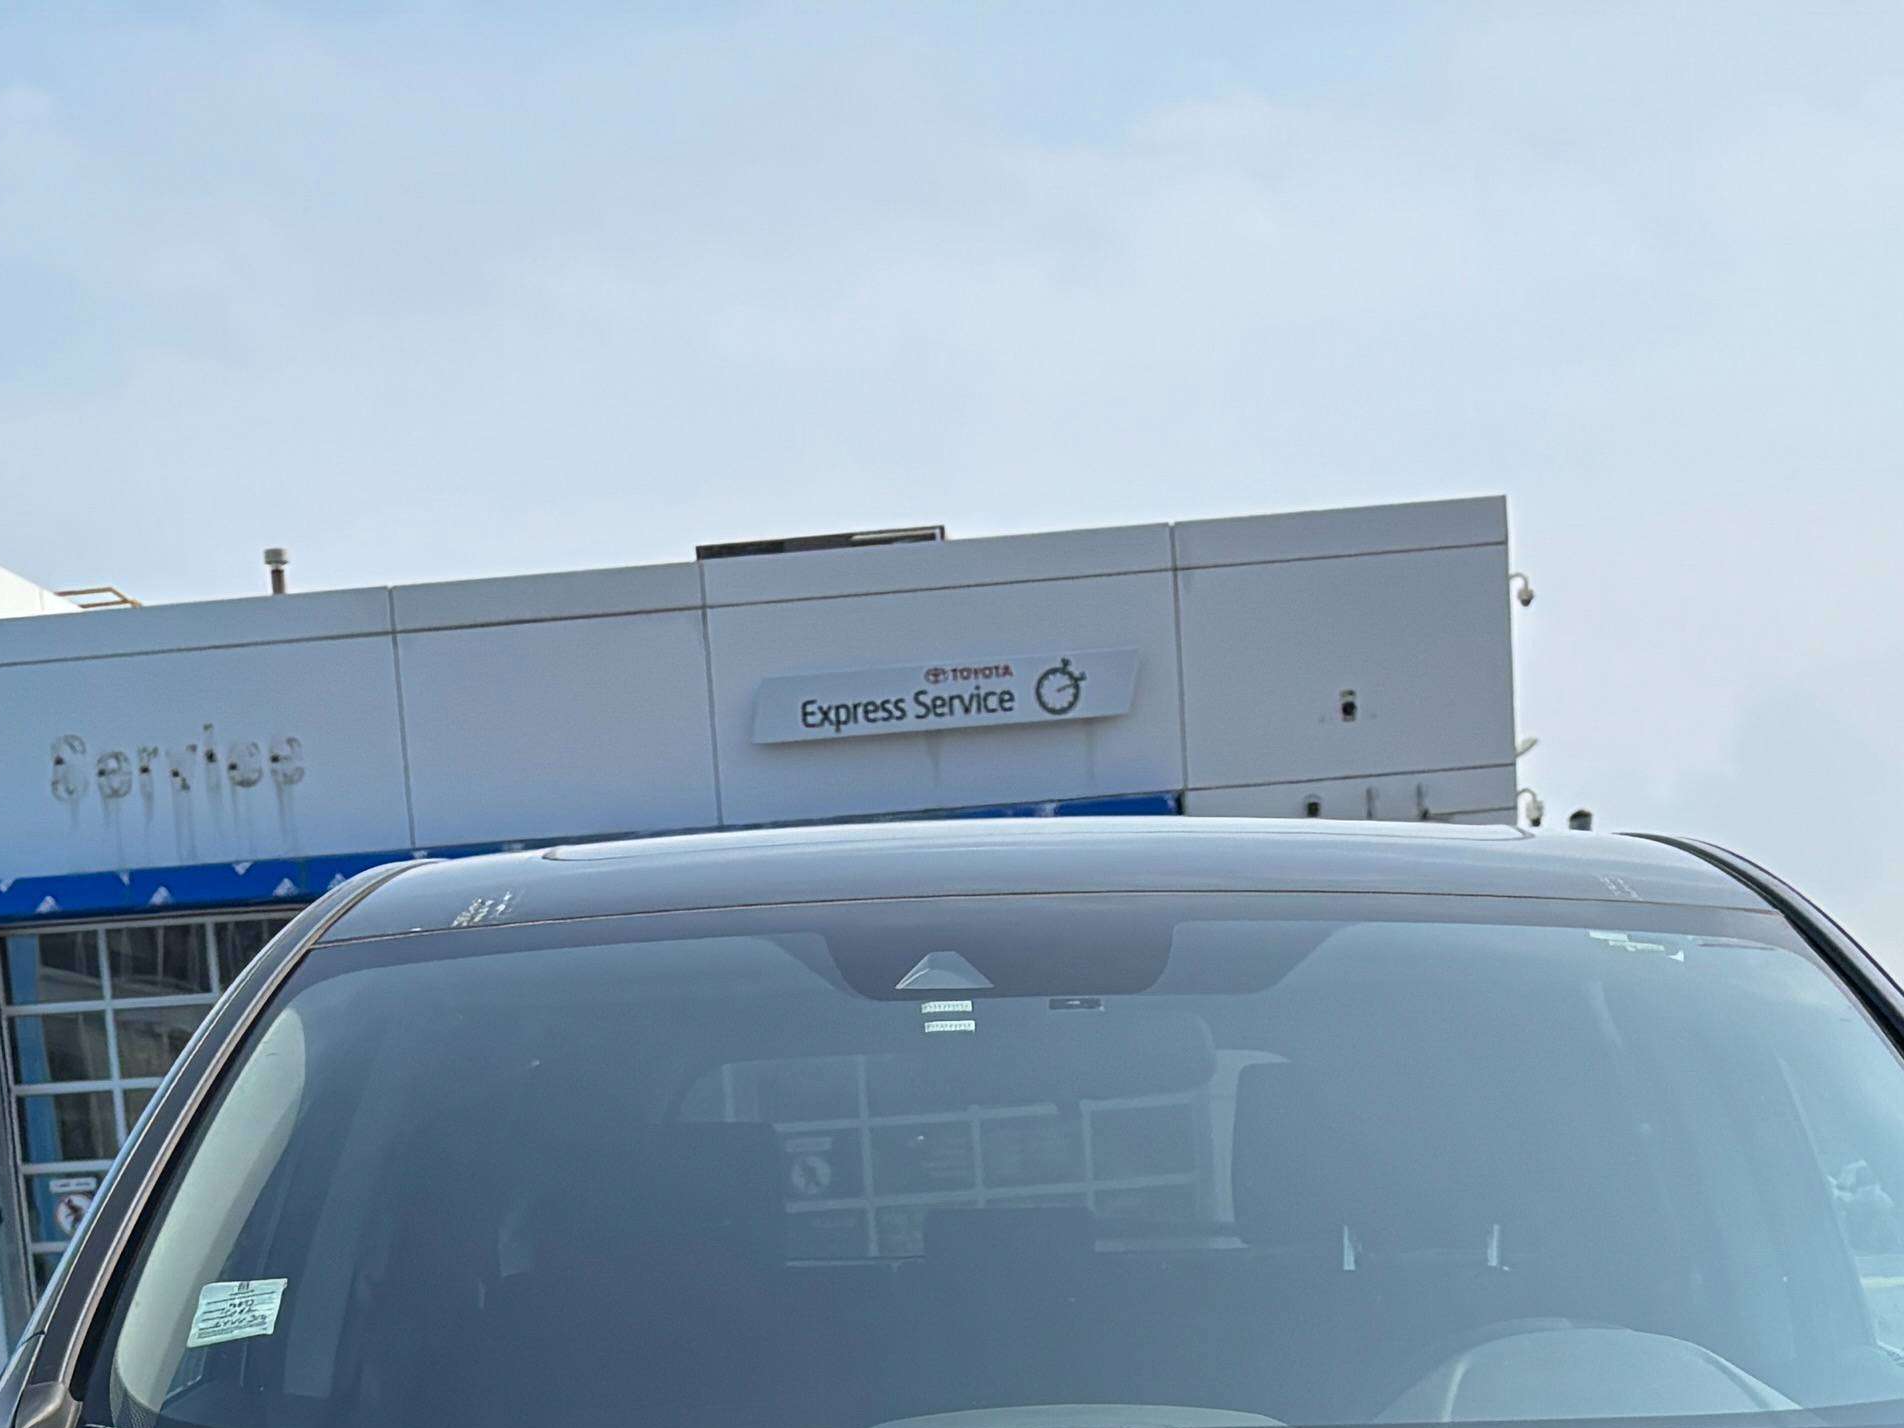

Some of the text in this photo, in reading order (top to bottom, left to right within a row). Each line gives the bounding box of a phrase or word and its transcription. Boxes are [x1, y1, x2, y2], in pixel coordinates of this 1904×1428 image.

[950, 664, 1013, 681] TOYOTA
[801, 685, 1016, 733] Express Service
